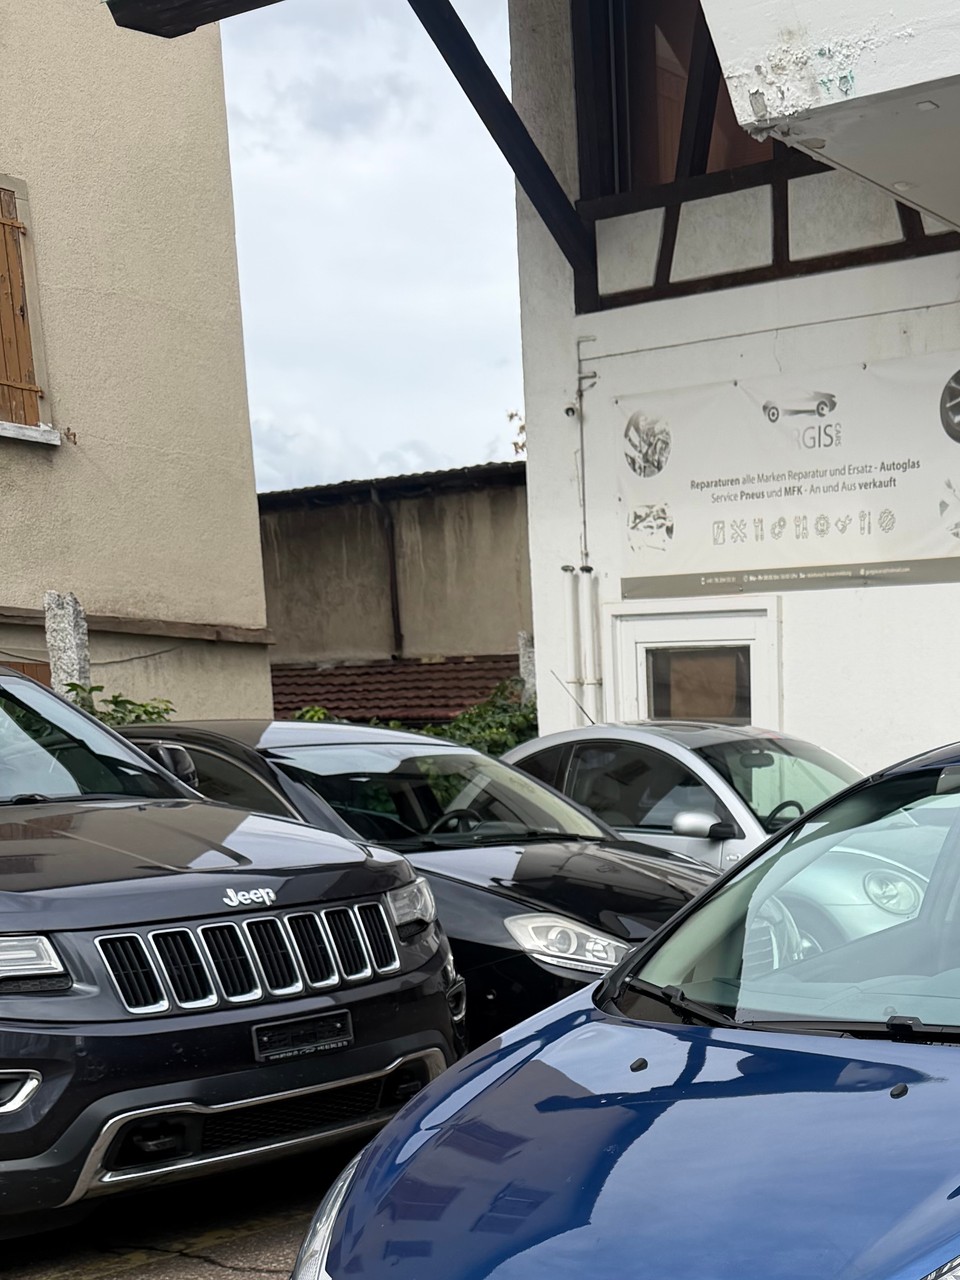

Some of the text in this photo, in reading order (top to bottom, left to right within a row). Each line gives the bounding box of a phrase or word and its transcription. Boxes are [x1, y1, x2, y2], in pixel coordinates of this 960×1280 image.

[690, 478, 741, 492] Reparaturen
[741, 474, 756, 486] alle
[757, 471, 787, 484] Marken
[788, 468, 829, 483] Reparatur
[829, 465, 846, 477] und
[847, 464, 872, 476] Ersatz
[880, 458, 921, 473] Autoglas
[711, 492, 739, 504] Service
[740, 488, 766, 501] Pneus
[766, 487, 783, 499] und
[784, 485, 803, 497] MFK
[809, 484, 821, 495] An
[822, 482, 840, 494] und
[841, 481, 857, 492] Aus
[858, 476, 897, 491] verkauft
[222, 888, 277, 907] Jeep
